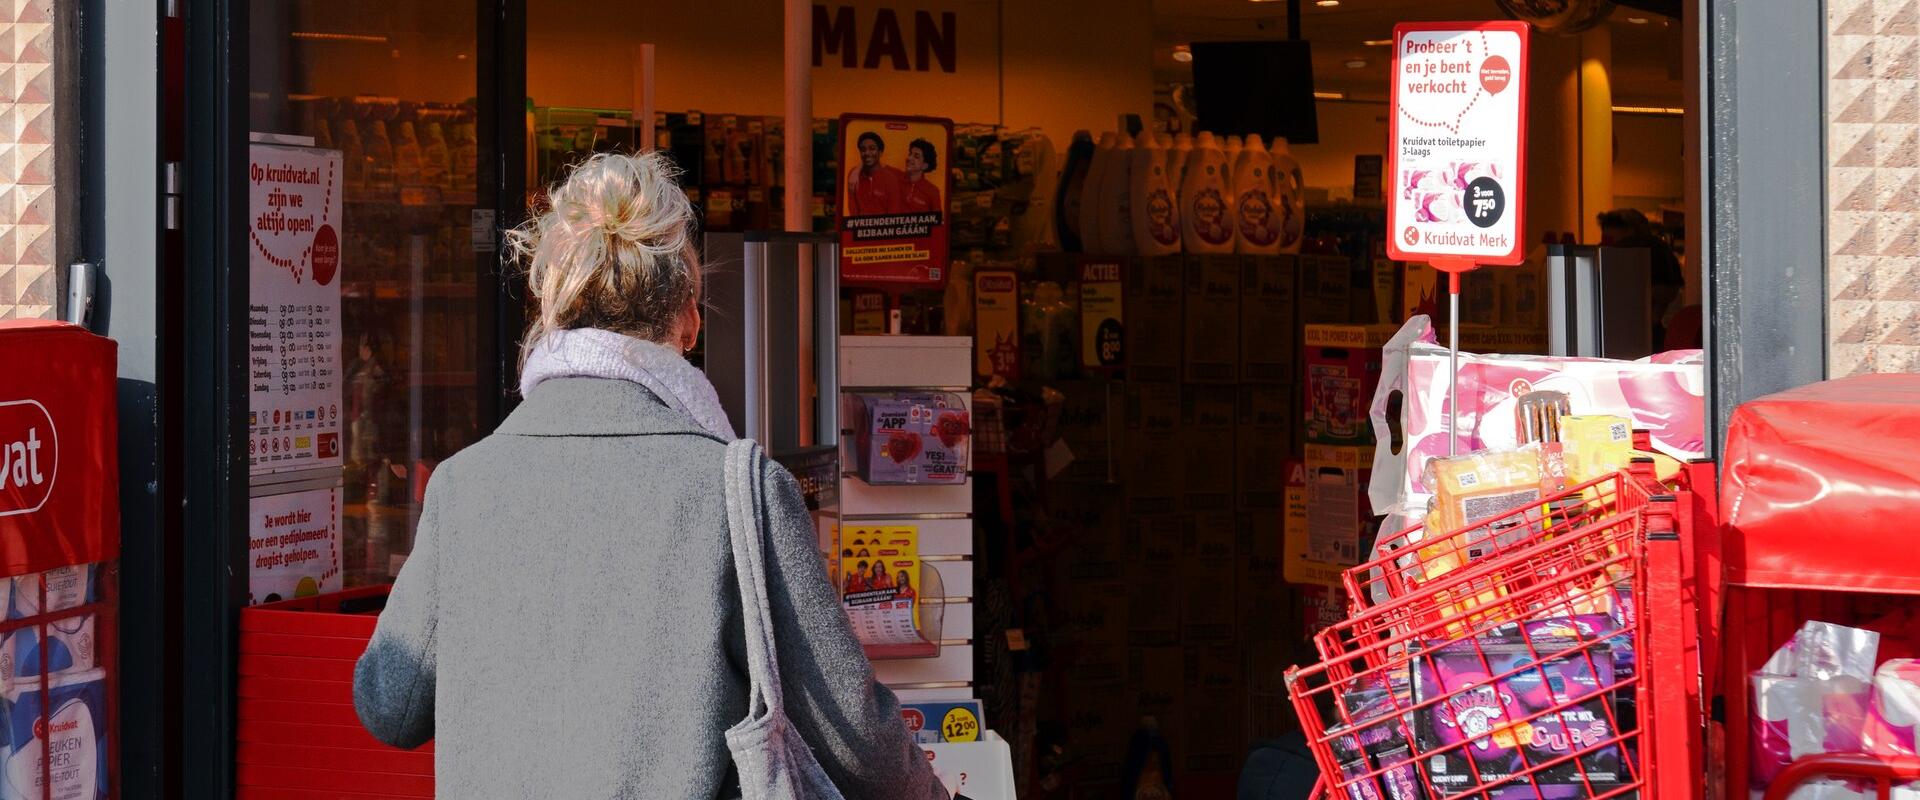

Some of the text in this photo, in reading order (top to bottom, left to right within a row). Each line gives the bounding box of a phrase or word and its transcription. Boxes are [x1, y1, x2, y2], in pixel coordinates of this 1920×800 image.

[812, 4, 956, 74] MAN
[1406, 40, 1457, 54] Probeer
[1405, 59, 1471, 78] en je bent
[1408, 79, 1467, 94] verkocht
[1403, 137, 1486, 148] Kruidvat toiletpapier
[1403, 147, 1431, 157] 3-laags
[251, 163, 320, 186] Op kruidvat.nl
[268, 187, 303, 212] zijn we
[1473, 186, 1481, 198] 3
[257, 212, 314, 236] altijd open!
[847, 215, 917, 229] #VRIENDENTEAM
[857, 228, 894, 238] BIJBAAN
[1424, 231, 1508, 248] Kruidvat Merk
[1083, 263, 1120, 281] ACTIE!
[884, 417, 906, 429] APP
[925, 451, 945, 461] YES!
[933, 464, 966, 475] GRATIS
[264, 508, 312, 529] Je wordt hier
[265, 533, 279, 548] een
[279, 525, 330, 549] gediplomeerd
[255, 547, 319, 571] drogist geholpen.
[949, 713, 956, 723] 3
[49, 719, 79, 734] Kruidvat
[946, 721, 976, 738] 12.00
[1530, 719, 1609, 751] CUBES
[49, 736, 82, 754] EUKEN
[960, 773, 967, 786] ?
